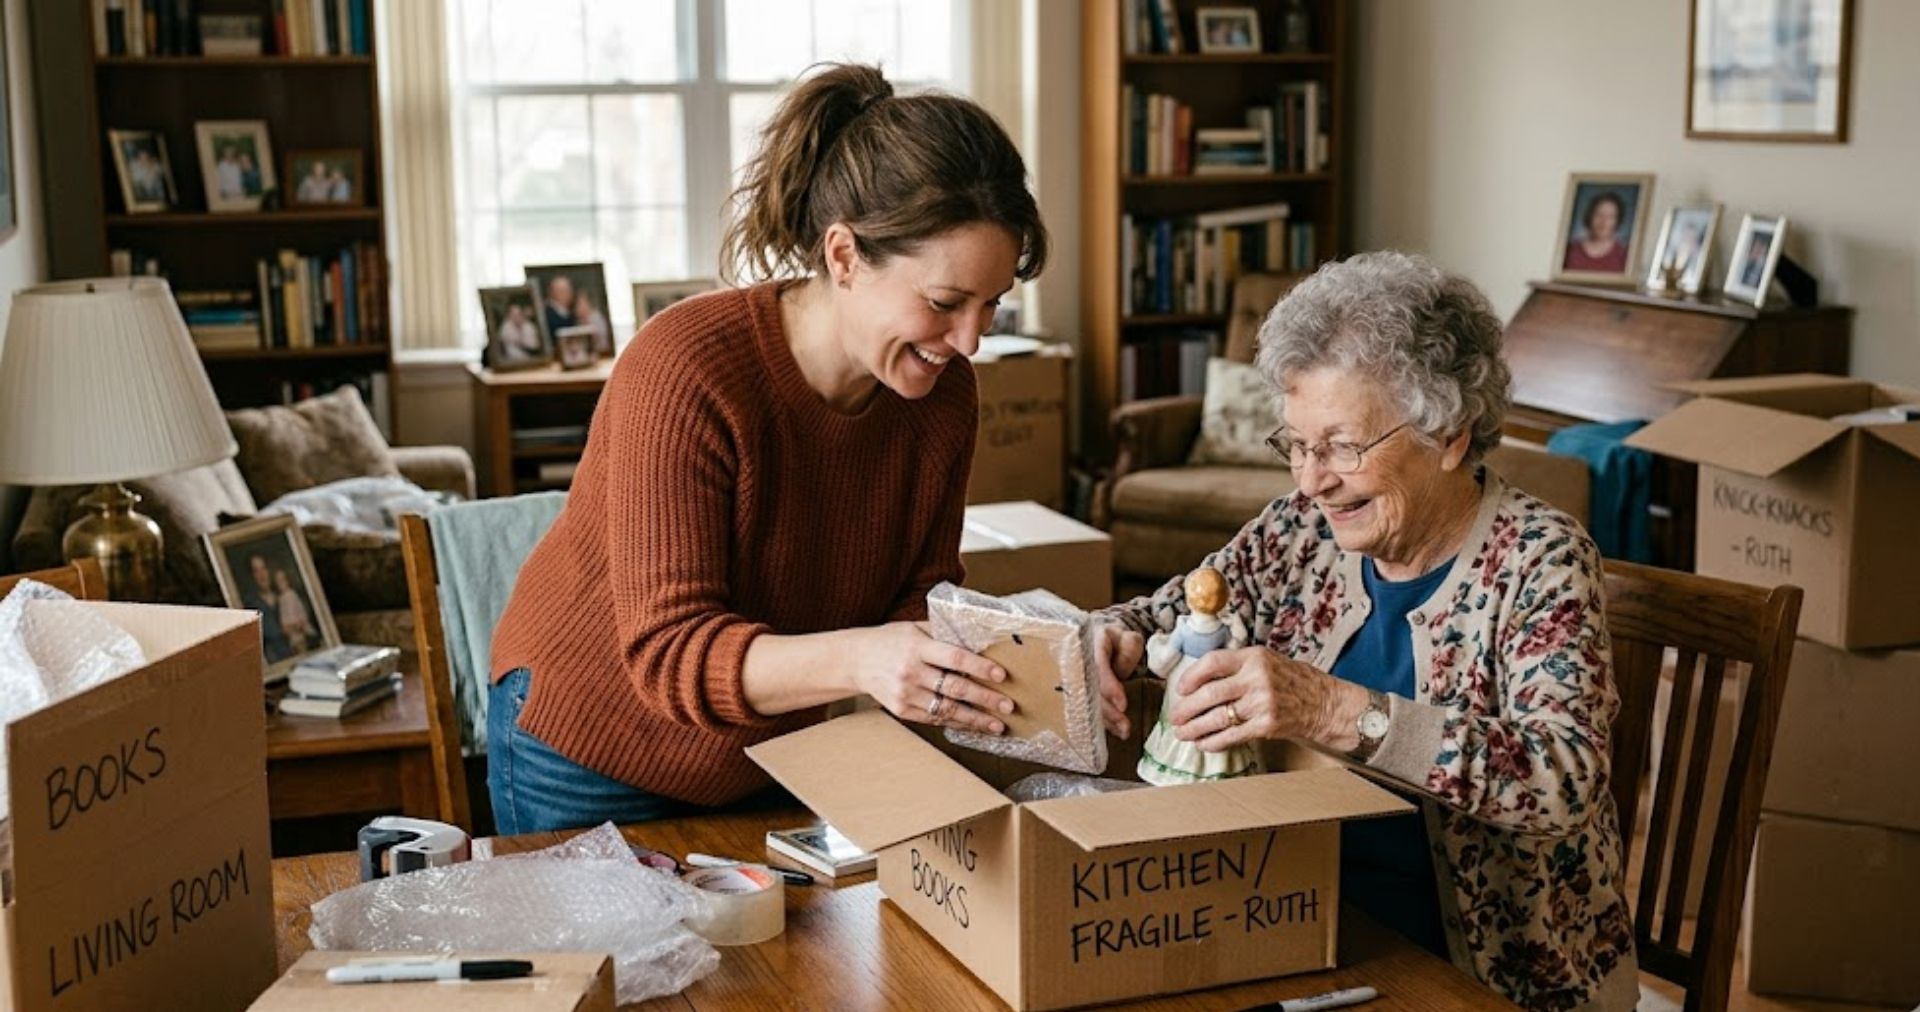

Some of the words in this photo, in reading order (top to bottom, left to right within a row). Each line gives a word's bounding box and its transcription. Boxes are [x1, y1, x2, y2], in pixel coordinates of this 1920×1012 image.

[45, 727, 166, 831] BOOKS
[48, 898, 160, 997] LIVING
[170, 848, 250, 934] ROOM
[911, 848, 969, 929] BOOKS
[1070, 906, 1213, 964] FRAGILE
